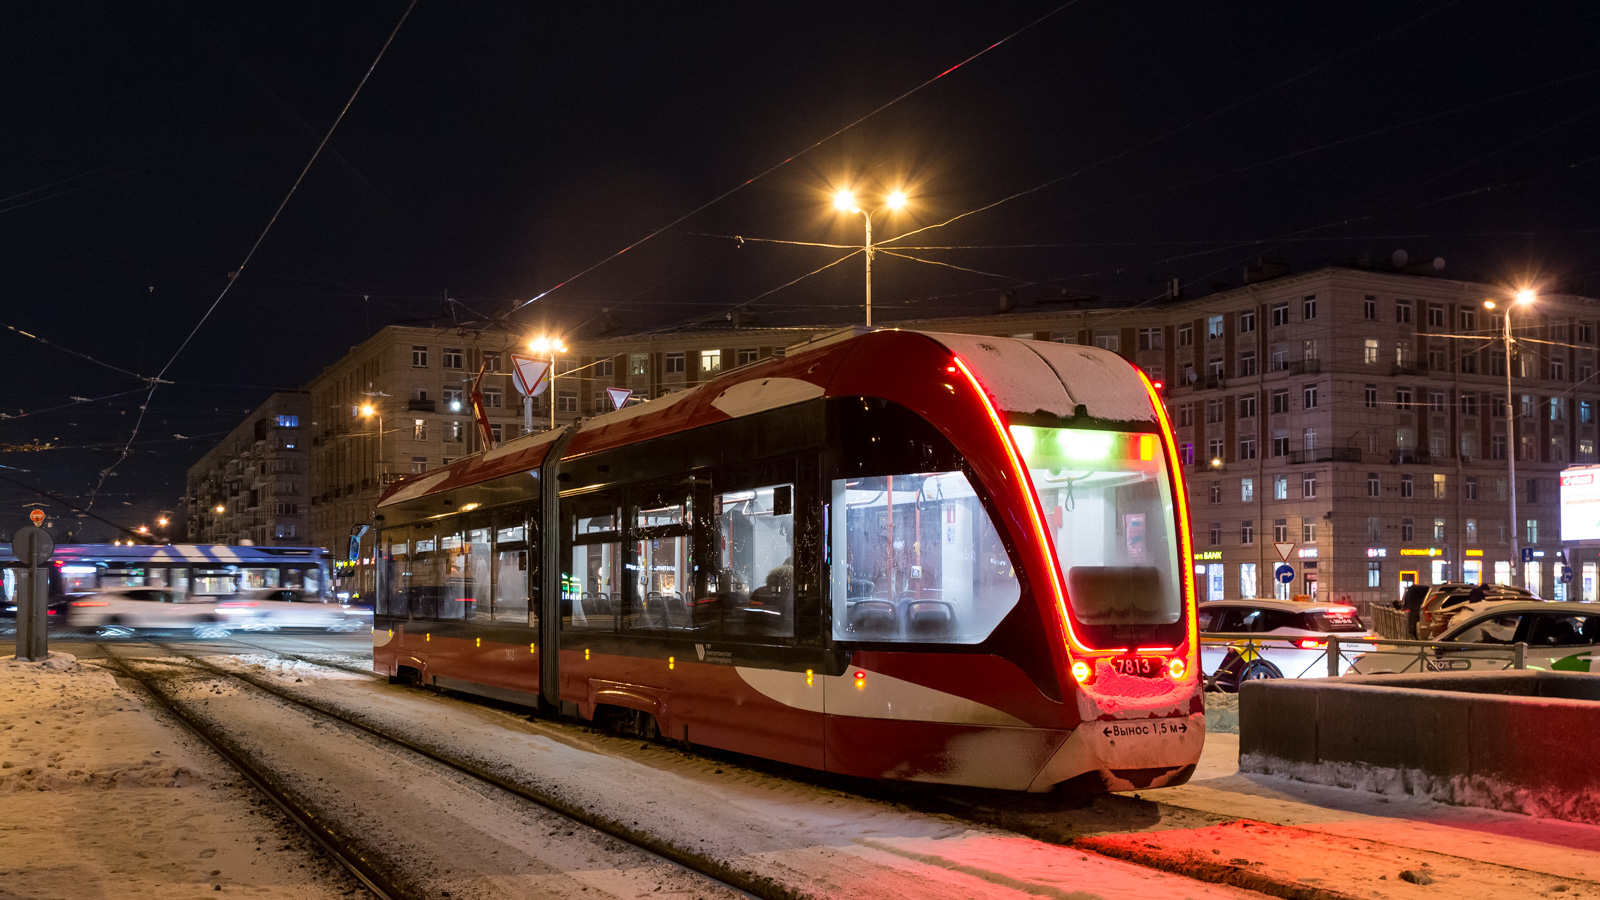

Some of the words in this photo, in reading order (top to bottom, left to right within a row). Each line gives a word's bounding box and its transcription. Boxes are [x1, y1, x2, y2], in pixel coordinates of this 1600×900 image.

[1203, 551, 1222, 560] BANK
[1116, 658, 1151, 674] 7813
[1112, 725, 1149, 736] Вынос
[1152, 723, 1167, 735] 1,5
[1170, 725, 1178, 733] м
